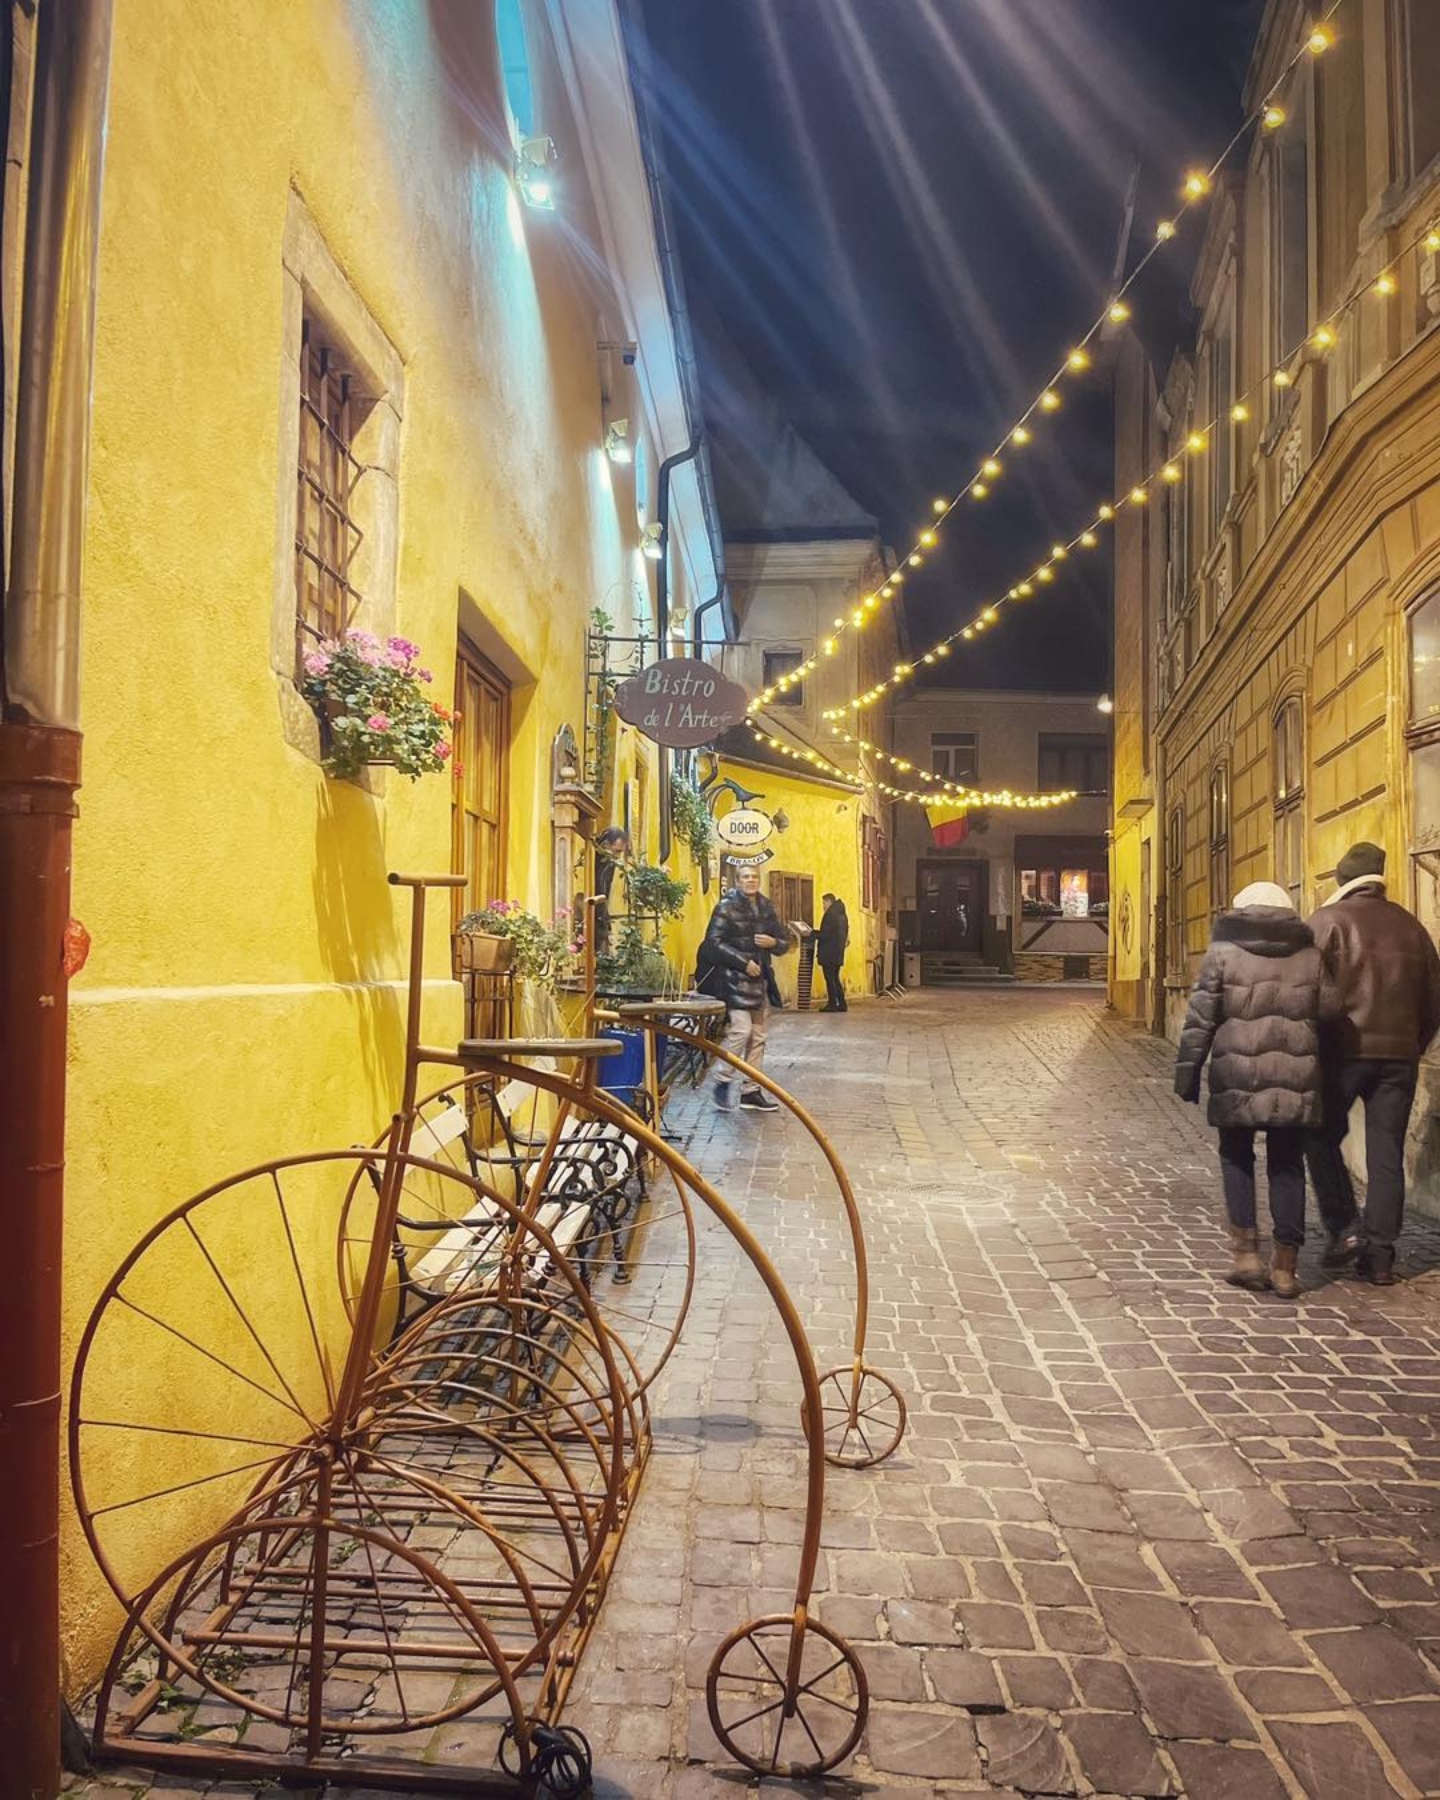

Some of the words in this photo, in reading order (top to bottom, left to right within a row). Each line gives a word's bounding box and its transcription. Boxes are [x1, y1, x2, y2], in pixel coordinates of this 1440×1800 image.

[644, 669, 716, 698] Bistro
[644, 710, 660, 728] de
[730, 822, 760, 834] DOOR
